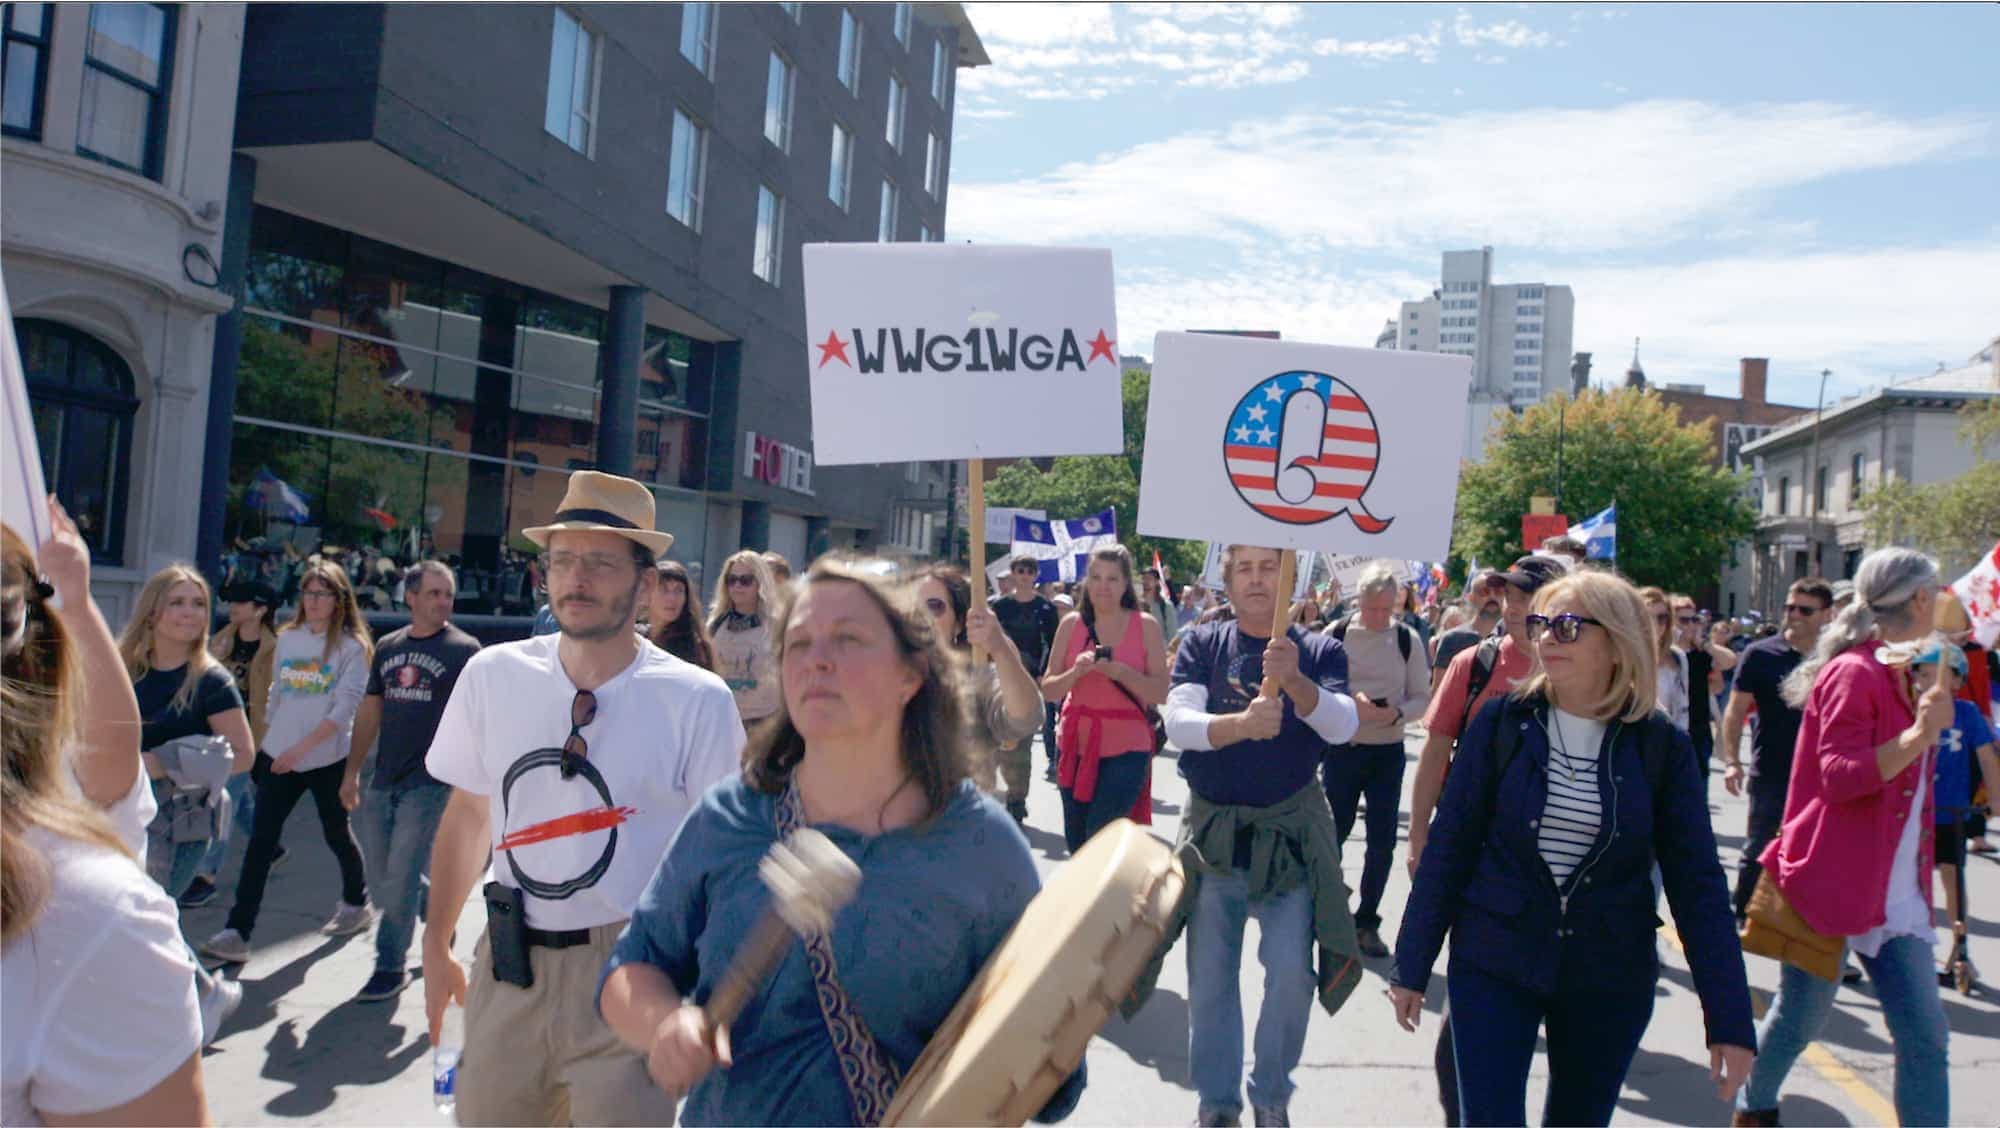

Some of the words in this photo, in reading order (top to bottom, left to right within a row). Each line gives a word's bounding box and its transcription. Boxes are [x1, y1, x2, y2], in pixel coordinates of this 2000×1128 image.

[852, 328, 1086, 374] WWG1WGA
[743, 432, 816, 497] HOTEL
[1223, 370, 1395, 534] Q
